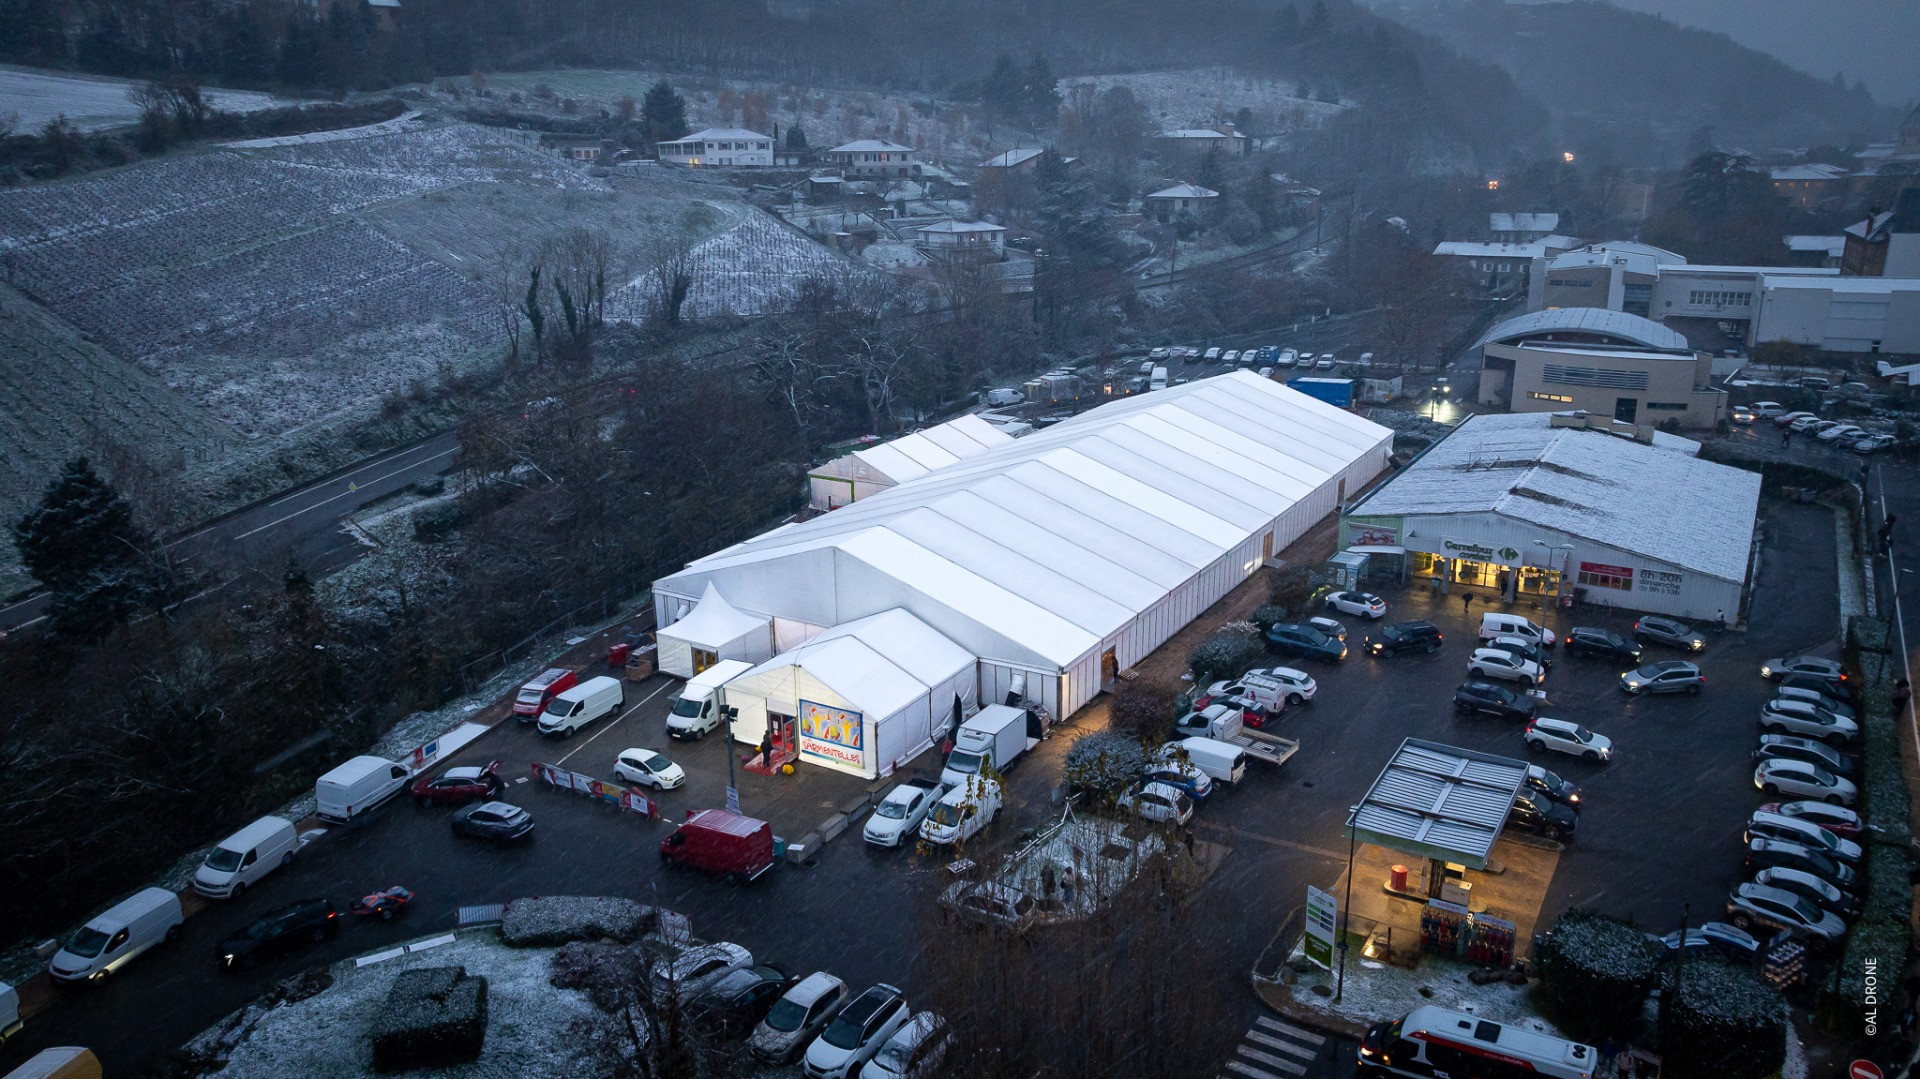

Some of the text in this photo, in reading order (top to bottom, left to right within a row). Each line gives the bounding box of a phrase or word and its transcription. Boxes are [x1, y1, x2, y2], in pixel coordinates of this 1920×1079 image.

[1444, 540, 1494, 554] Carrefour
[1459, 552, 1493, 561] contact
[1640, 569, 1655, 579] 8h
[1659, 572, 1682, 583] 20h
[1639, 579, 1680, 590] dimanche
[802, 740, 860, 764] SARMENTELLES
